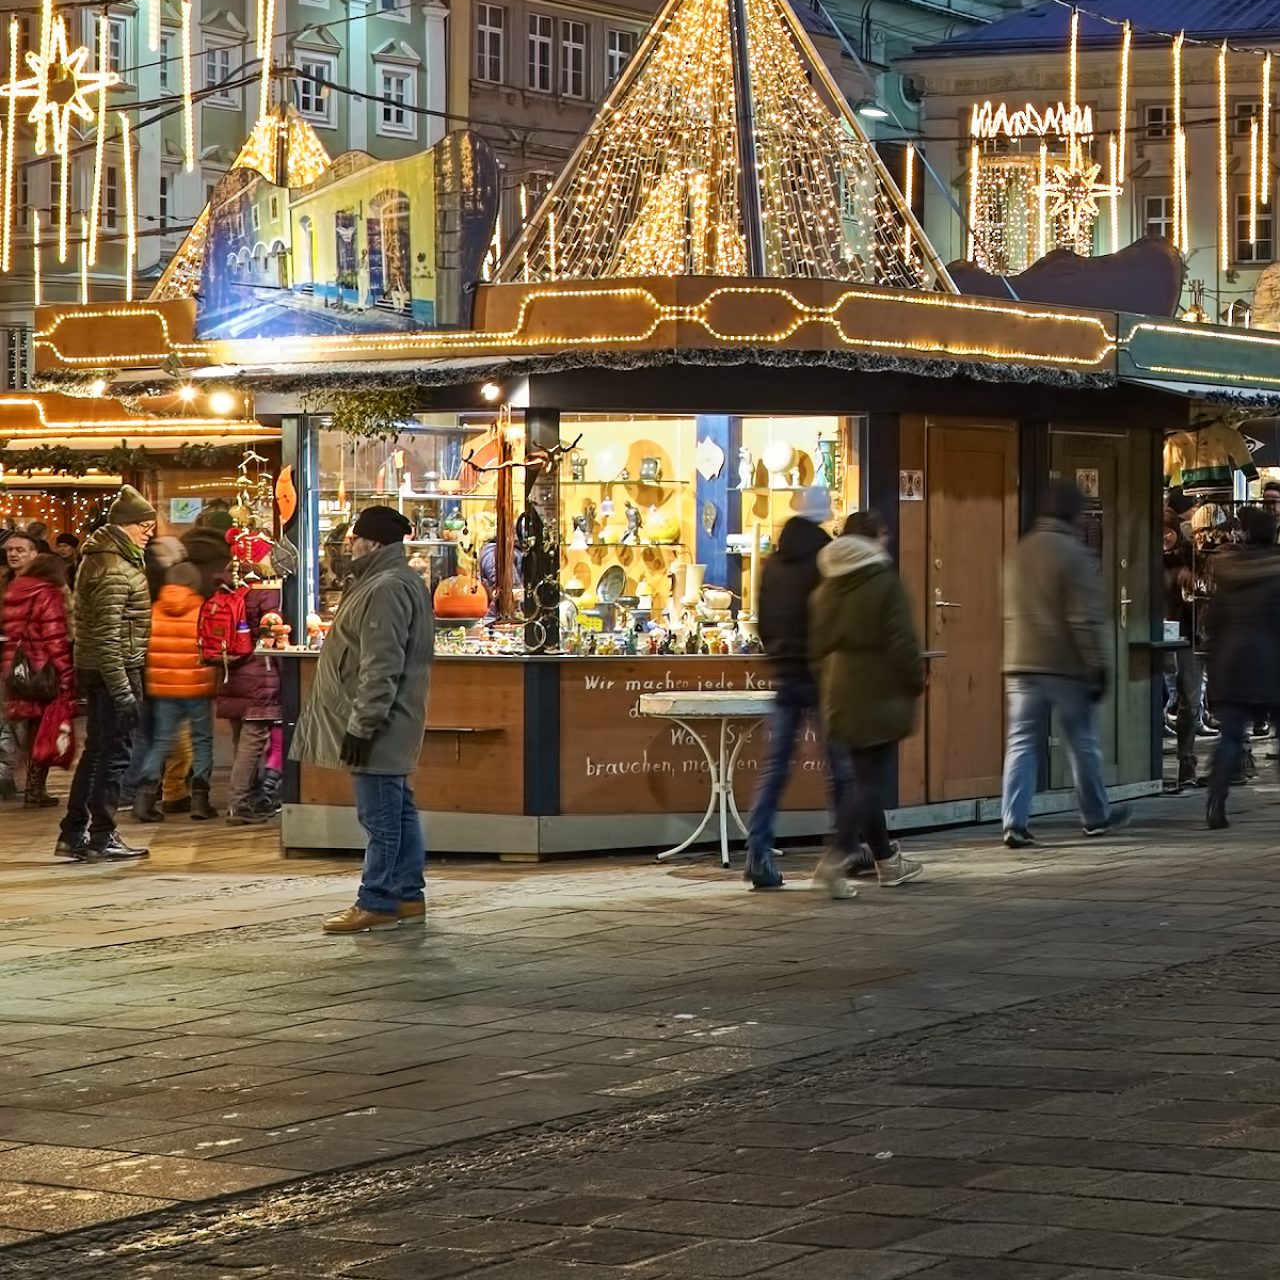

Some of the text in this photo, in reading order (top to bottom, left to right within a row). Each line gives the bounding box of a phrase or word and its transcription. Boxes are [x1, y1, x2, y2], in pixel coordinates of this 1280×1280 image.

[584, 675, 615, 690] Wir
[625, 670, 689, 691] machen
[697, 671, 734, 691] jede
[586, 749, 675, 777] brauchen,
